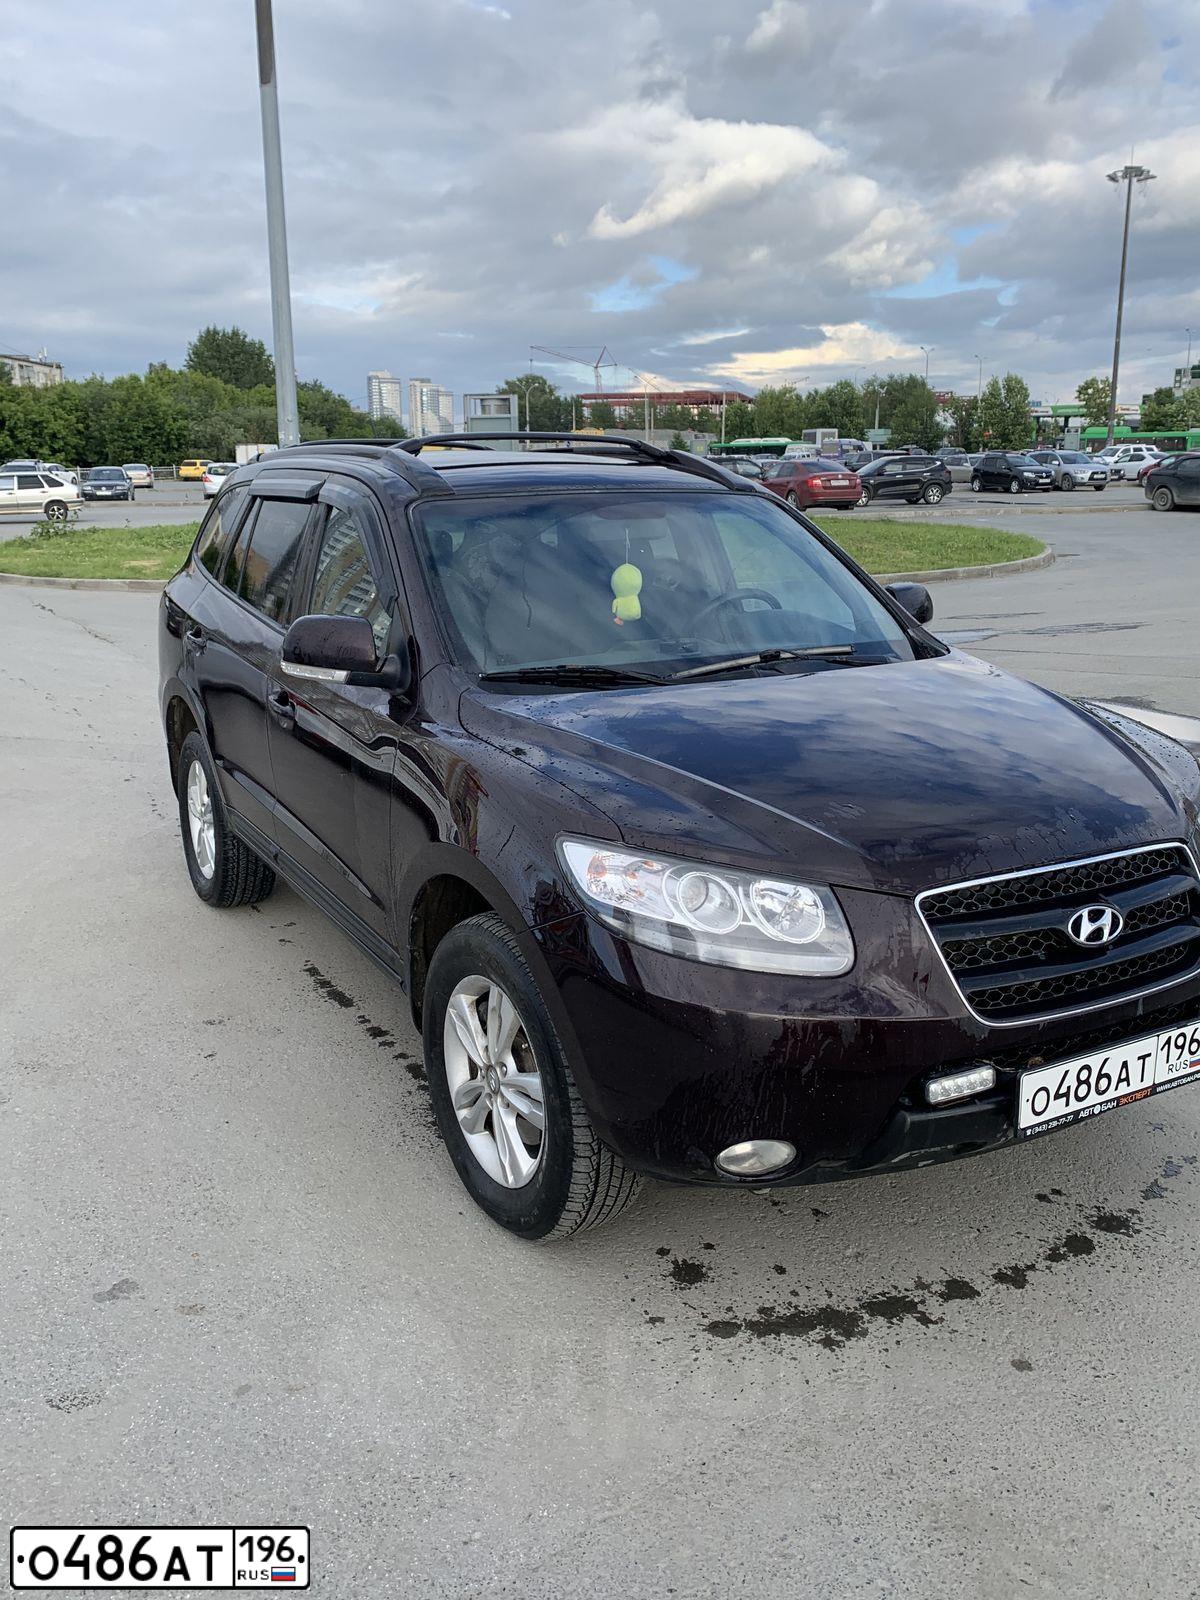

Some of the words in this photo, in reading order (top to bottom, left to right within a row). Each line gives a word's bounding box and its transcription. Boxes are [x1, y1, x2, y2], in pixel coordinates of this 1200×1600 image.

[1160, 1027, 1200, 1064] 196
[1167, 1059, 1189, 1075] RUS
[1119, 1088, 1153, 1106] ЭКСПЕРТ
